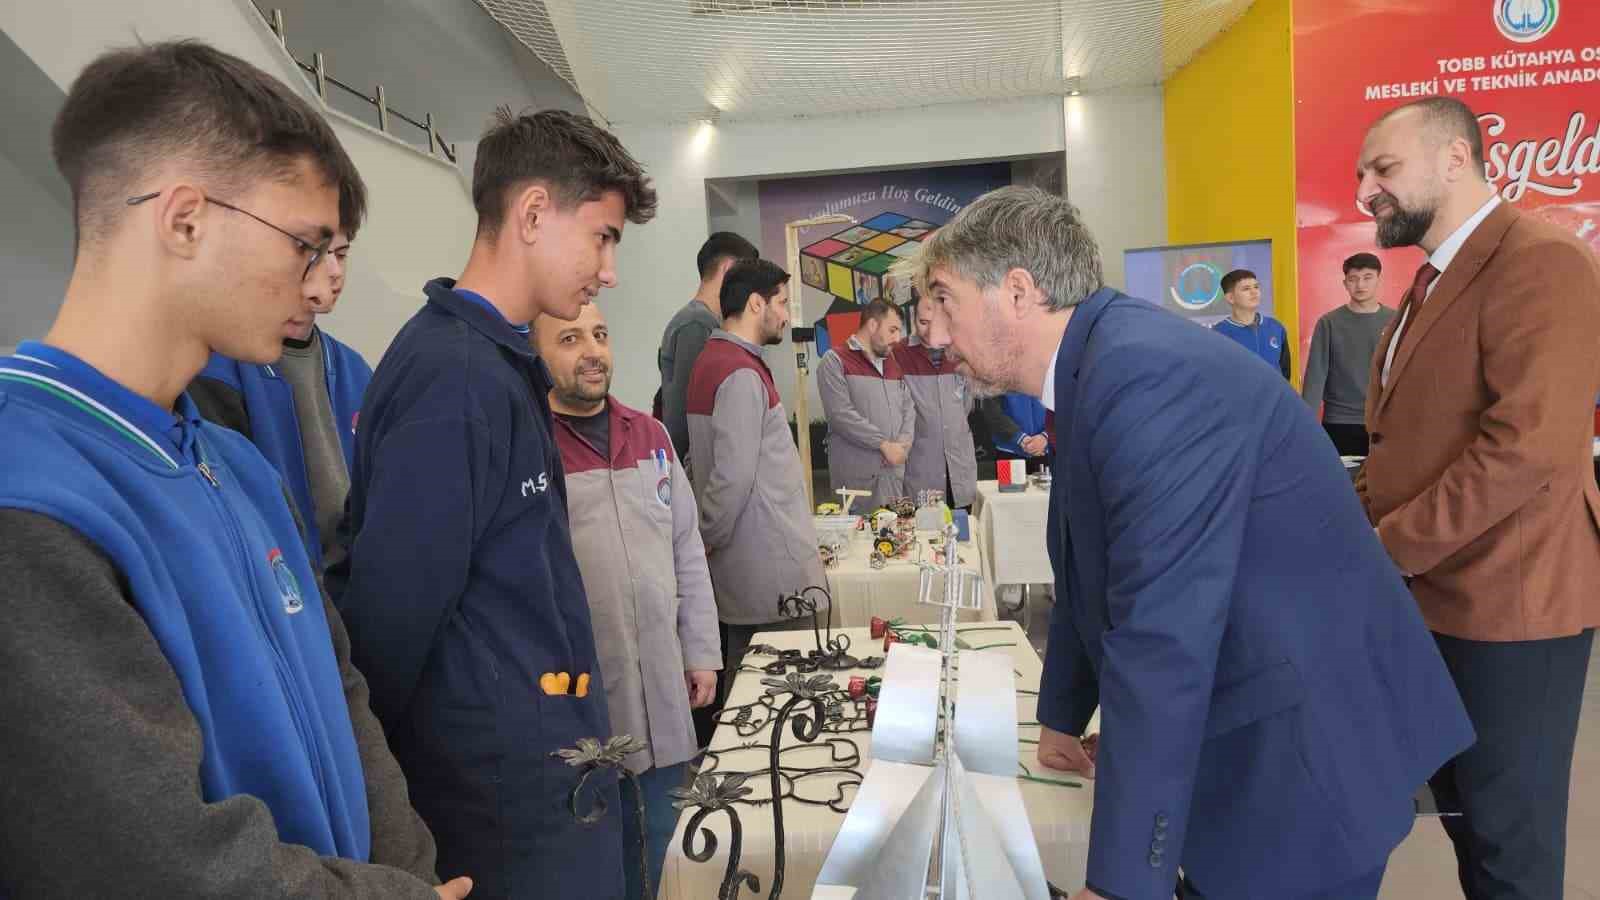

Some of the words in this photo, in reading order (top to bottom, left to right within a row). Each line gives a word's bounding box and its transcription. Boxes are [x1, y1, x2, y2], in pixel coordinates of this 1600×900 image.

[1437, 56, 1485, 74] TOBB
[1491, 49, 1575, 69] KÜTAHYA
[1365, 77, 1438, 101] MESLEKİ
[1444, 78, 1466, 94] VE
[1471, 71, 1537, 92] TEKNİK
[1542, 68, 1600, 86] ANAD
[914, 187, 961, 214] Geldin
